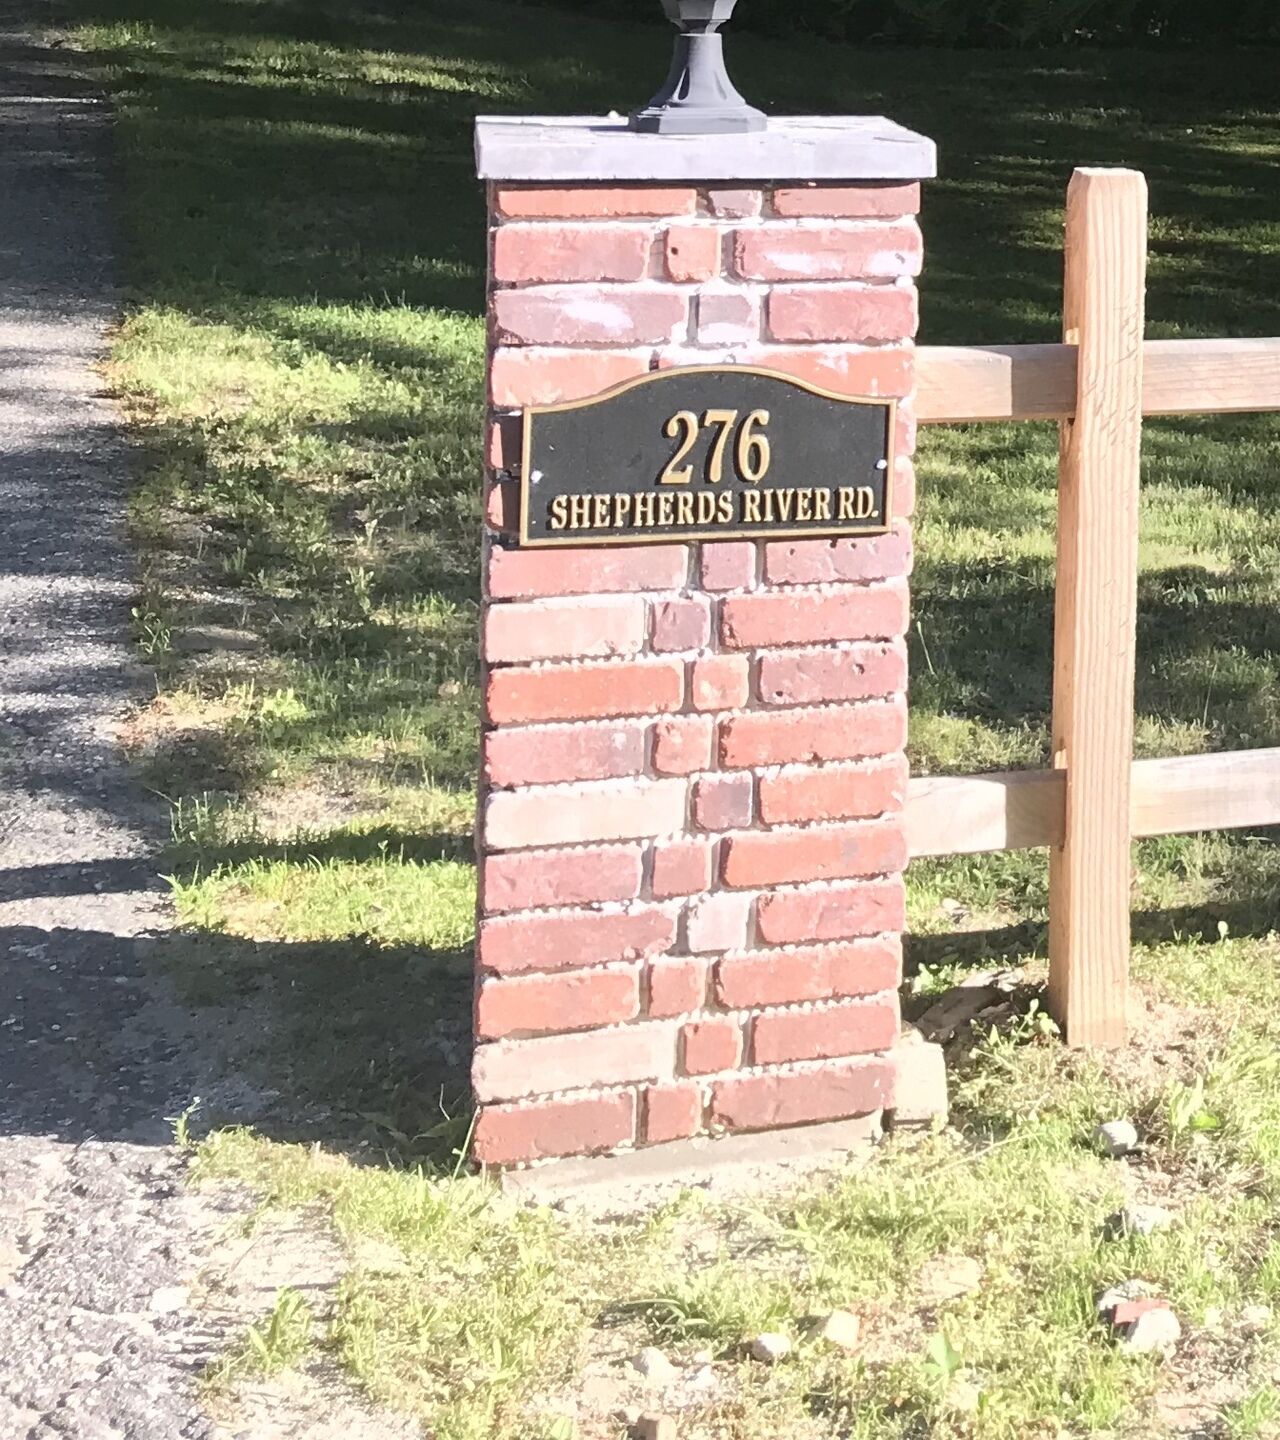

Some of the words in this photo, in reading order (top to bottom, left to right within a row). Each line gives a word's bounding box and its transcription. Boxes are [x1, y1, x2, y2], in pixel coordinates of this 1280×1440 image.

[660, 409, 770, 485] 276
[551, 489, 734, 530] SHEPHERDS
[744, 487, 831, 523] RIVER
[837, 486, 880, 520] RD.
